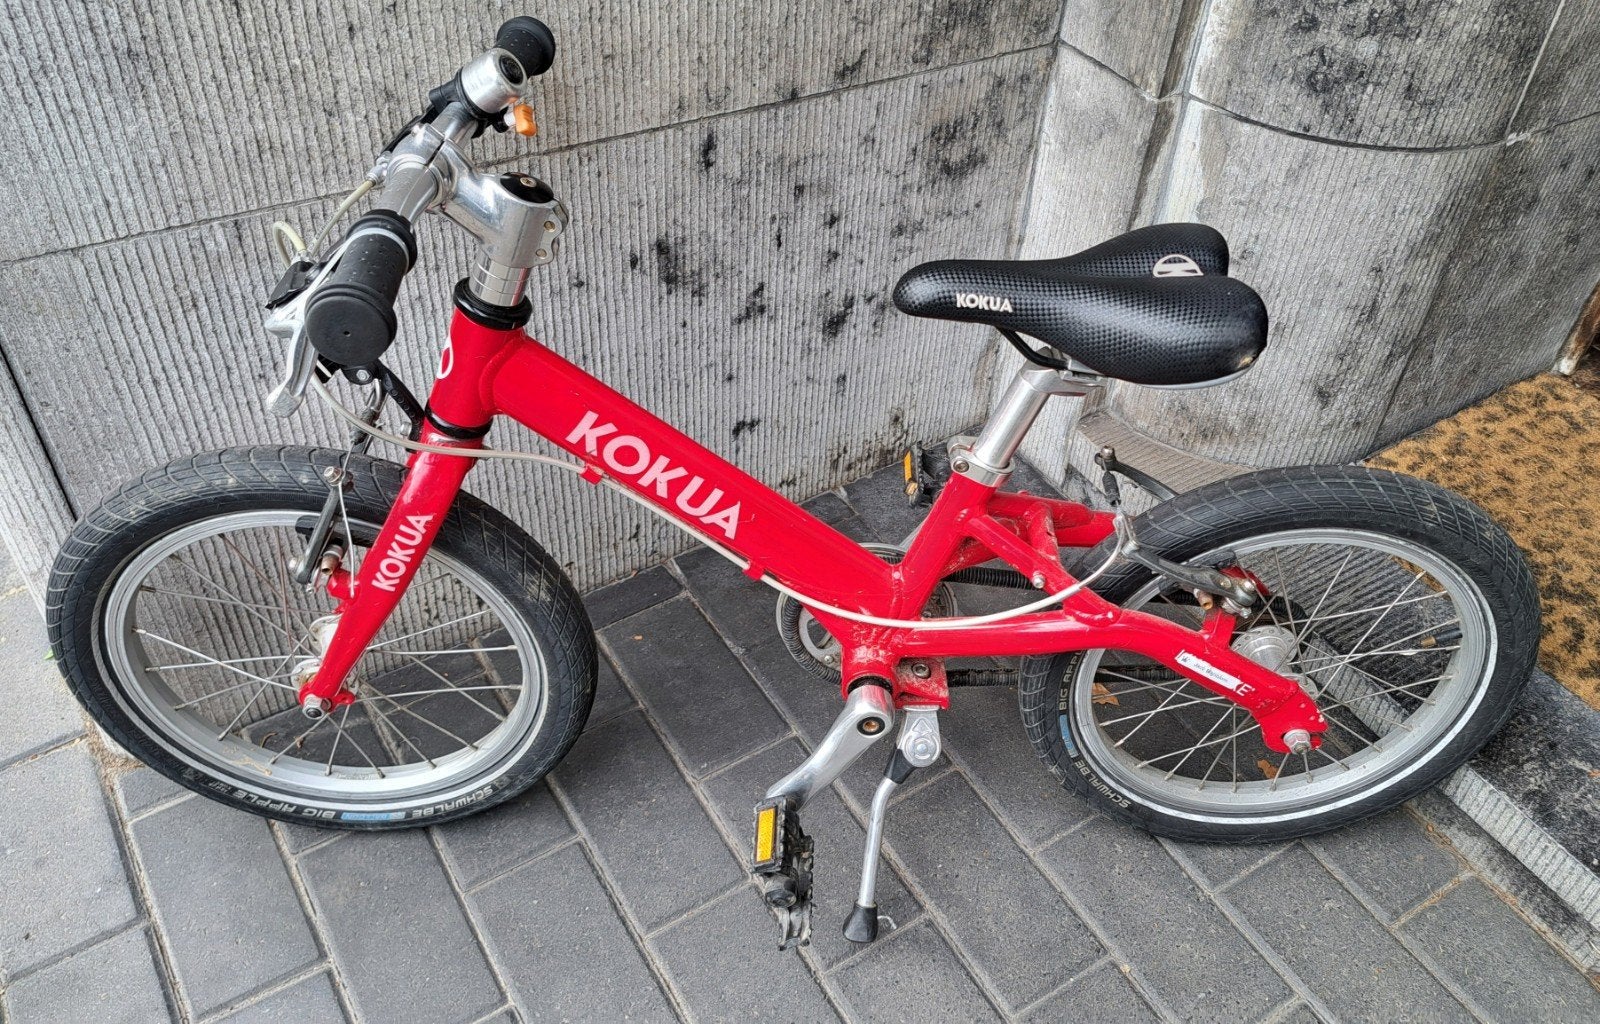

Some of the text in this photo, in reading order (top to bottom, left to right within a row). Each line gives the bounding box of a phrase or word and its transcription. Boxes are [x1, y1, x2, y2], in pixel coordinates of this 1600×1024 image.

[955, 292, 1014, 314] KOKUA
[564, 410, 741, 540] KOKUA
[371, 512, 434, 592] KOKUA
[1063, 652, 1083, 682] APPL
[1058, 688, 1069, 711] BIG
[1074, 759, 1132, 809] SCHWALBE
[232, 789, 299, 813] APPLE
[301, 807, 338, 820] BIG
[412, 784, 495, 818] SCHWALBE
